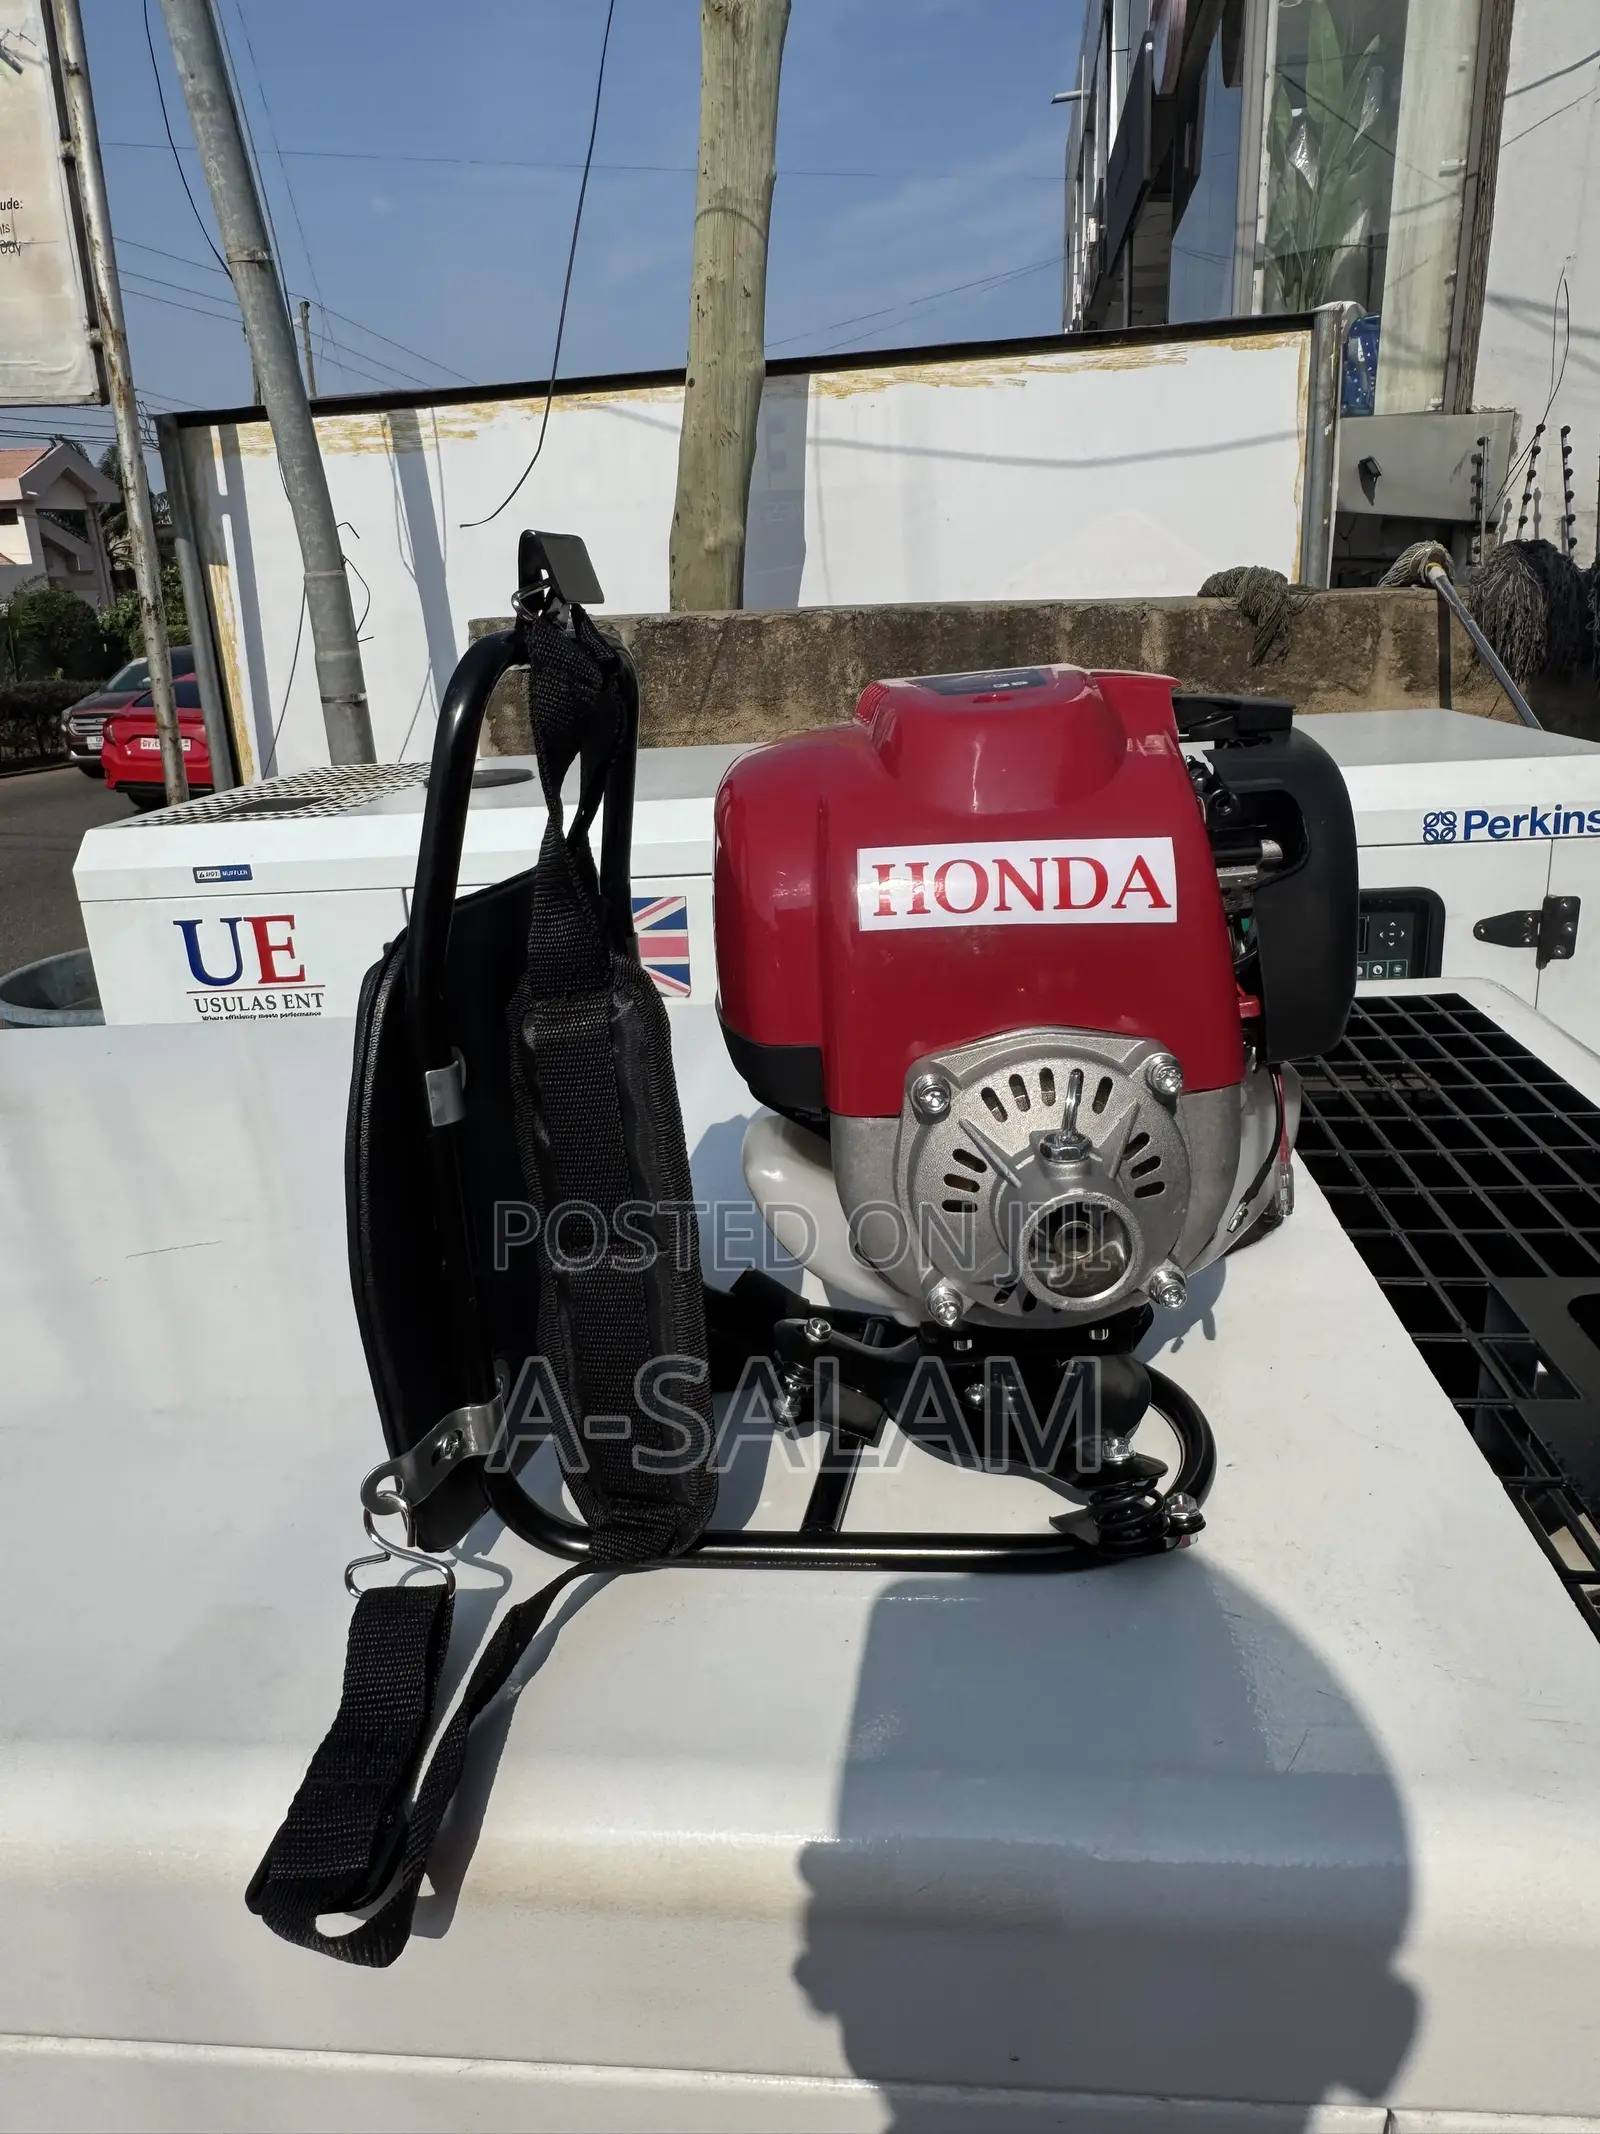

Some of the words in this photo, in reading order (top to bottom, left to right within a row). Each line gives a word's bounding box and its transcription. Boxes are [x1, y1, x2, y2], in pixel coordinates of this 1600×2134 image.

[1463, 804, 1600, 841] Perkins
[872, 855, 1172, 916] HONDA
[173, 914, 306, 987] UE
[194, 995, 277, 1013] USULAS
[282, 992, 324, 1009] ENT
